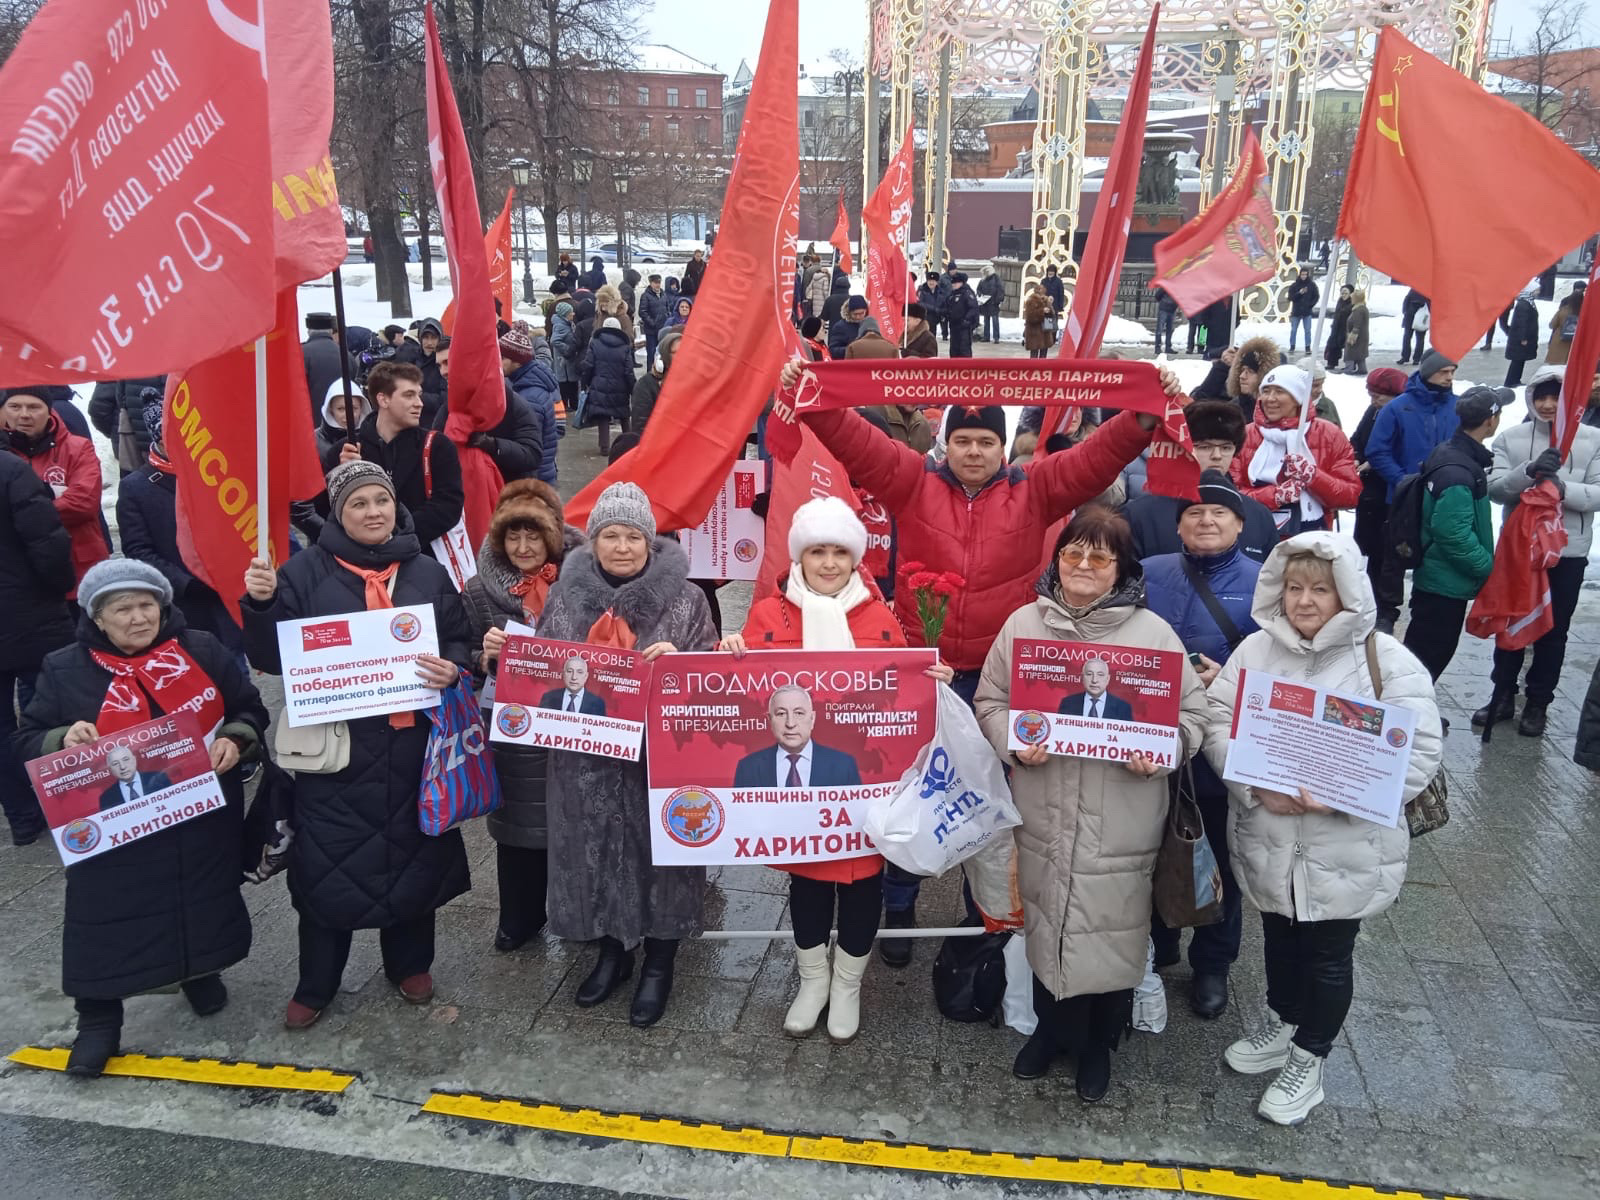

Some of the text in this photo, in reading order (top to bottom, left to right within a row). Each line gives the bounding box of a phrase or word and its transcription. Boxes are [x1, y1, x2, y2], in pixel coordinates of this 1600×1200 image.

[871, 369, 1124, 385] КОММУНИСТИЧЕСКАЯ ПАРТИЯ
[884, 383, 1102, 401] РОССИЙСКОЙ ФЕДЕРАЦИИ
[505, 658, 549, 670] ХАРИТОНОВА
[521, 642, 634, 669] ПОДМОСКОВЬЕ
[1035, 645, 1162, 670] ПОДМОСКОВЬЕ
[290, 666, 324, 677] Слава
[326, 657, 389, 672] советскому
[511, 666, 562, 679] ПРЕЗИДЕНТЫ
[1018, 663, 1066, 673] ХАРИТОНОВА
[291, 671, 394, 694] победителю
[686, 669, 898, 696] ПОДМОСКОВЬЕ
[1025, 671, 1081, 683] ПРЕЗИДЕНТЫ
[294, 690, 375, 708] гитлеровского
[825, 702, 875, 711] ПОИГРАЛИ
[661, 704, 740, 717] ХАРИТОНОВА
[825, 710, 918, 724] В КАПИТАЛИЗМ
[535, 711, 641, 733] ЖЕНЩИНЫ ПОДМОСКОВЬЯ
[662, 717, 767, 732] В ПРЕЗИДЕНТЫ
[866, 724, 918, 737] ХВАТИТ!
[1055, 717, 1104, 730] ЖЕНЩИНЫ
[1106, 723, 1175, 739] ПОДМОСКОВЬЯ
[581, 728, 592, 736] ЗА
[1107, 735, 1118, 743] ЗА
[52, 720, 177, 770] ПОДМОСКОВЬЕ
[533, 733, 637, 760] ХАРИТОНОВА!
[42, 768, 92, 790] ХАРИТОНОВА
[53, 769, 110, 796] ПРЕЗИДЕНТЫ
[100, 775, 215, 822] ЖЕНЩИНЫ ПОДМОСКОВЬЯ
[732, 786, 897, 803] ЖЕНЩИНЫ ПОДМОСК
[155, 804, 167, 813] ЗА
[819, 807, 852, 828] ЗА
[108, 795, 222, 847] ХАРИТОНОВА!
